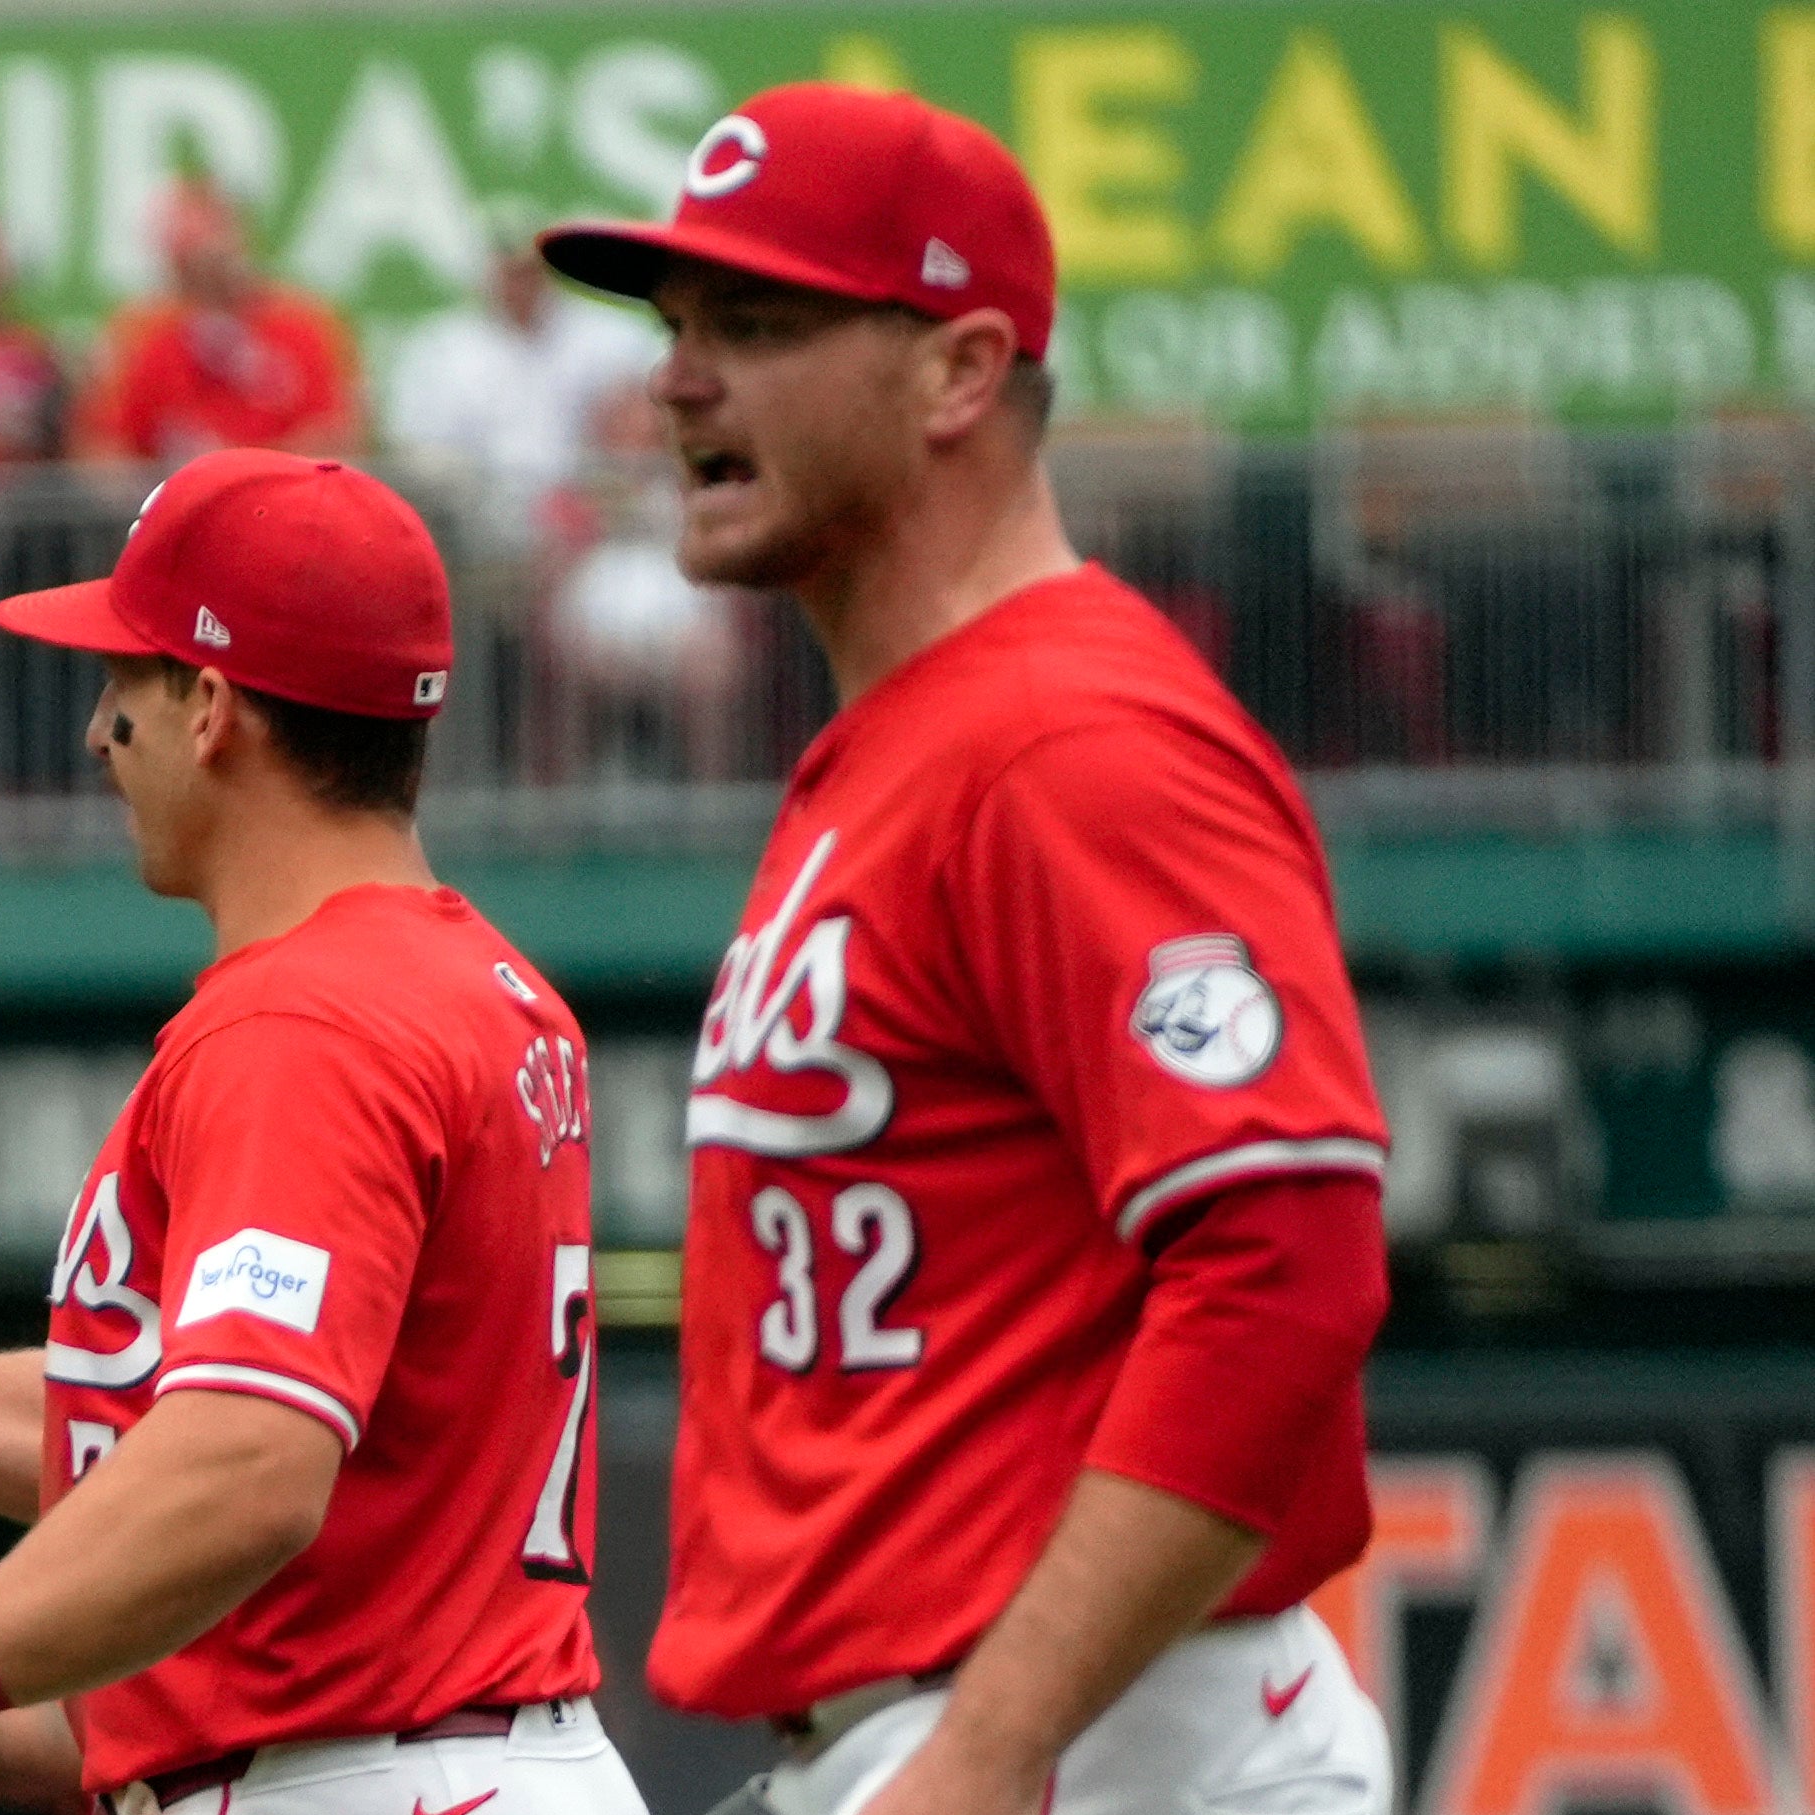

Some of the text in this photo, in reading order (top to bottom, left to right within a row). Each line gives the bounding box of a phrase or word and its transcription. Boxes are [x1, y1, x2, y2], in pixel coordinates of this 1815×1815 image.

[686, 113, 767, 199] C
[820, 16, 1660, 292] EAN
[751, 1183, 925, 1374] 32
